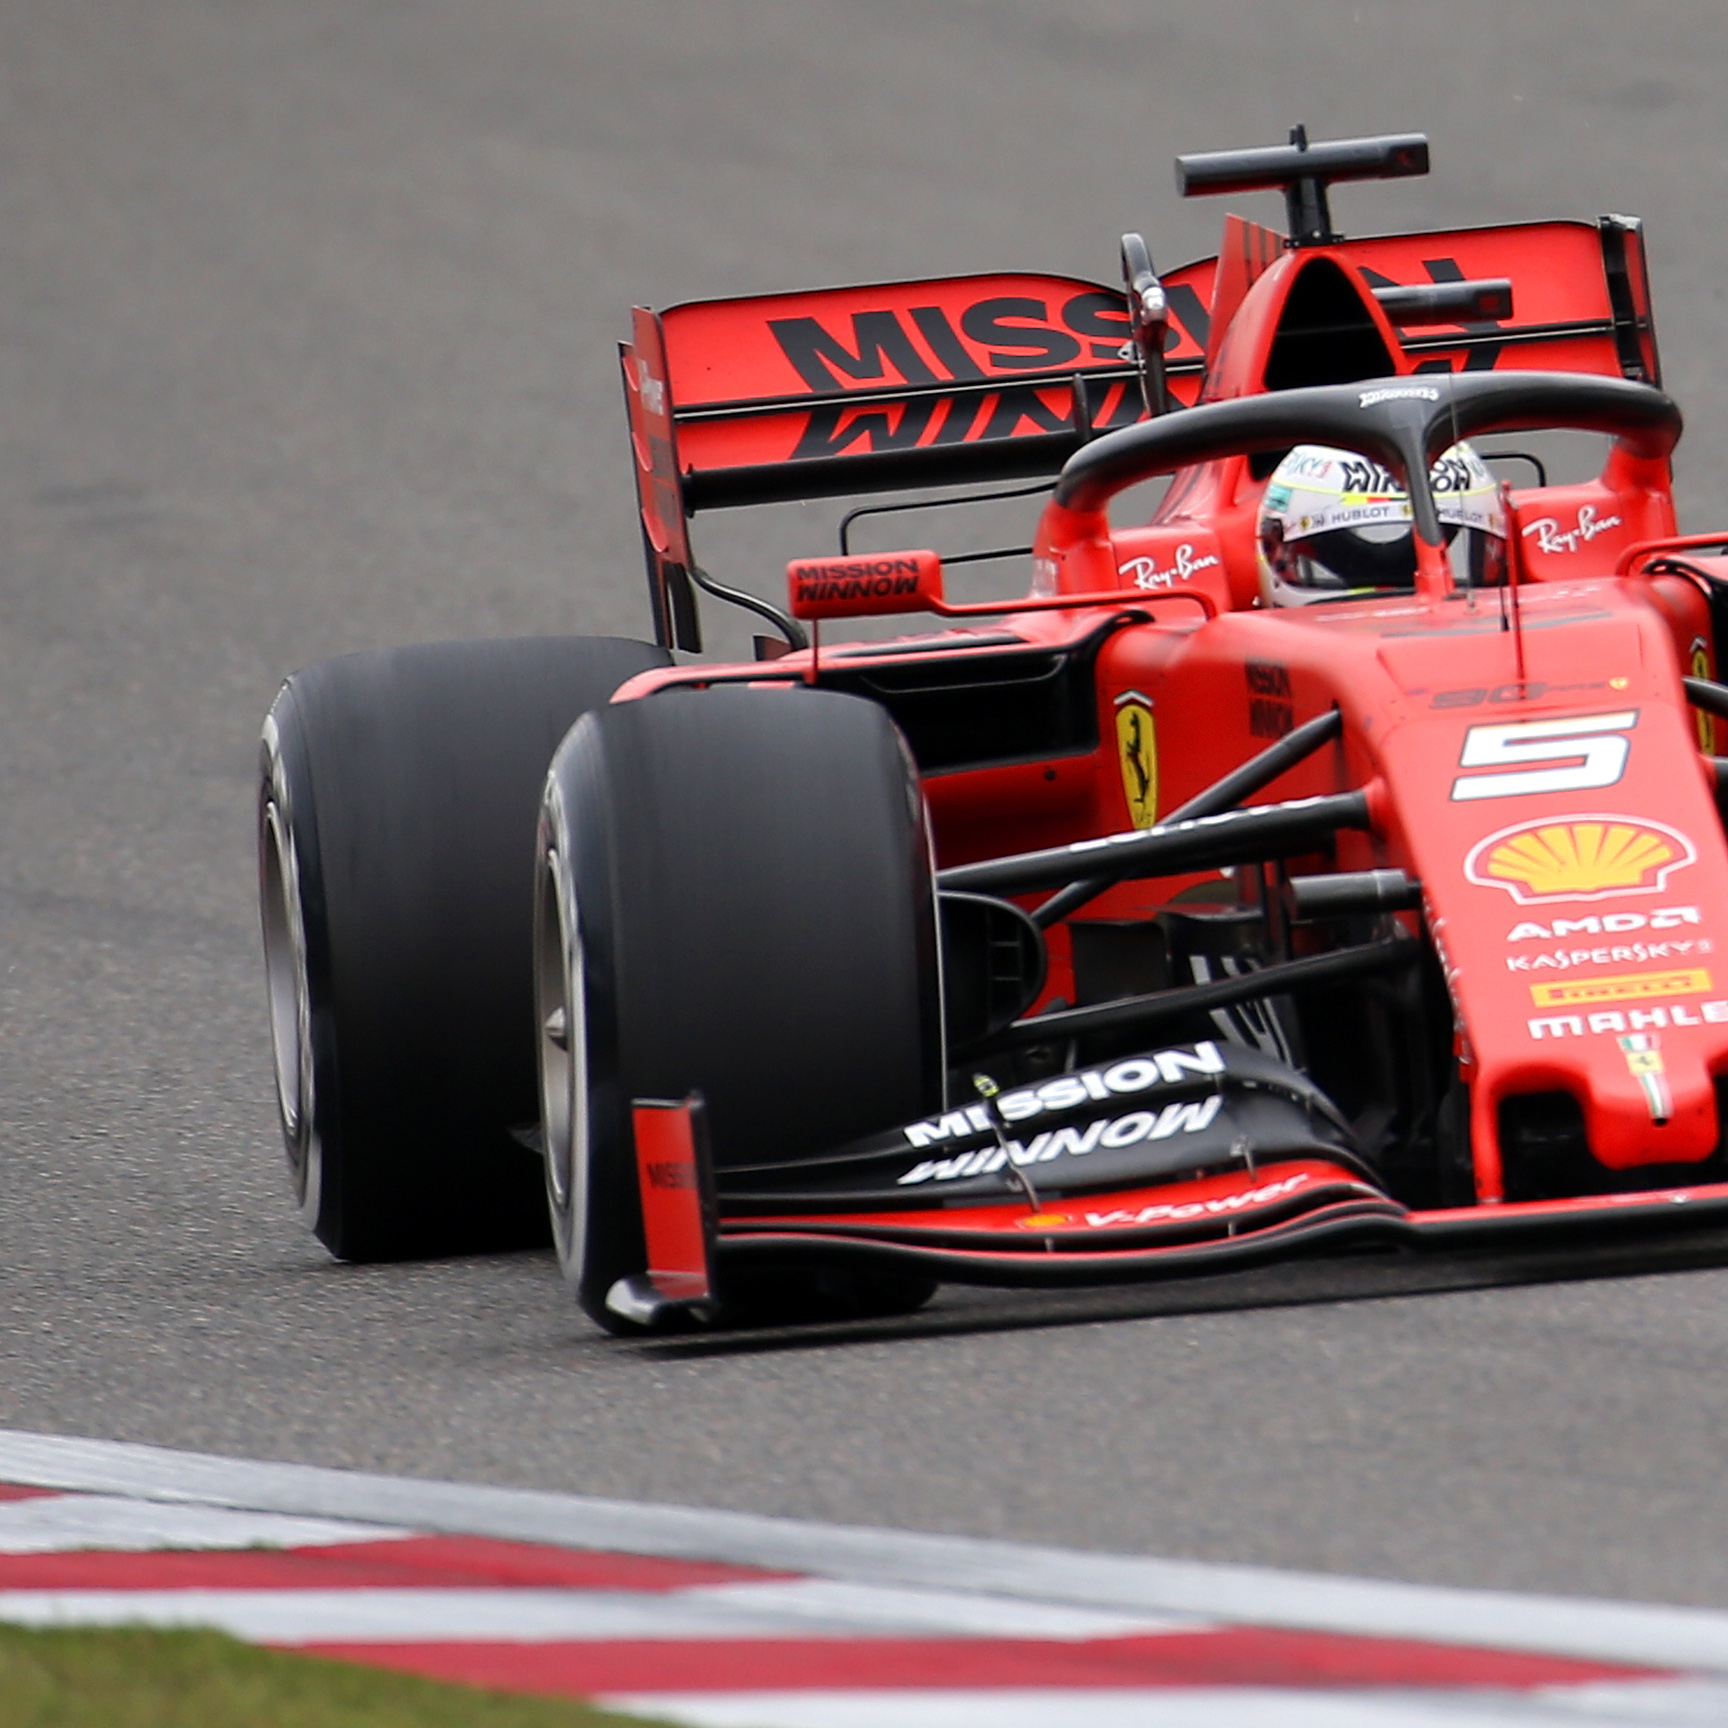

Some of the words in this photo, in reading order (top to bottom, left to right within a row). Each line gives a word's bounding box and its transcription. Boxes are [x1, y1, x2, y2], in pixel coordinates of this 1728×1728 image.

[765, 284, 1205, 393] MISSI
[1332, 506, 1390, 522] HUBLOT
[1521, 504, 1621, 554] Ray-Ban
[796, 559, 919, 581] MISSION
[797, 576, 919, 602] WINNOW
[1119, 544, 1219, 590] Ray-Ban
[1449, 708, 1641, 802] 5
[1506, 912, 1650, 942] AMD
[1506, 940, 1695, 972] KASPERSKY
[903, 1040, 1229, 1148] MISSION
[897, 1094, 1225, 1186] WINNOW
[1084, 1173, 1309, 1227] V-Power
